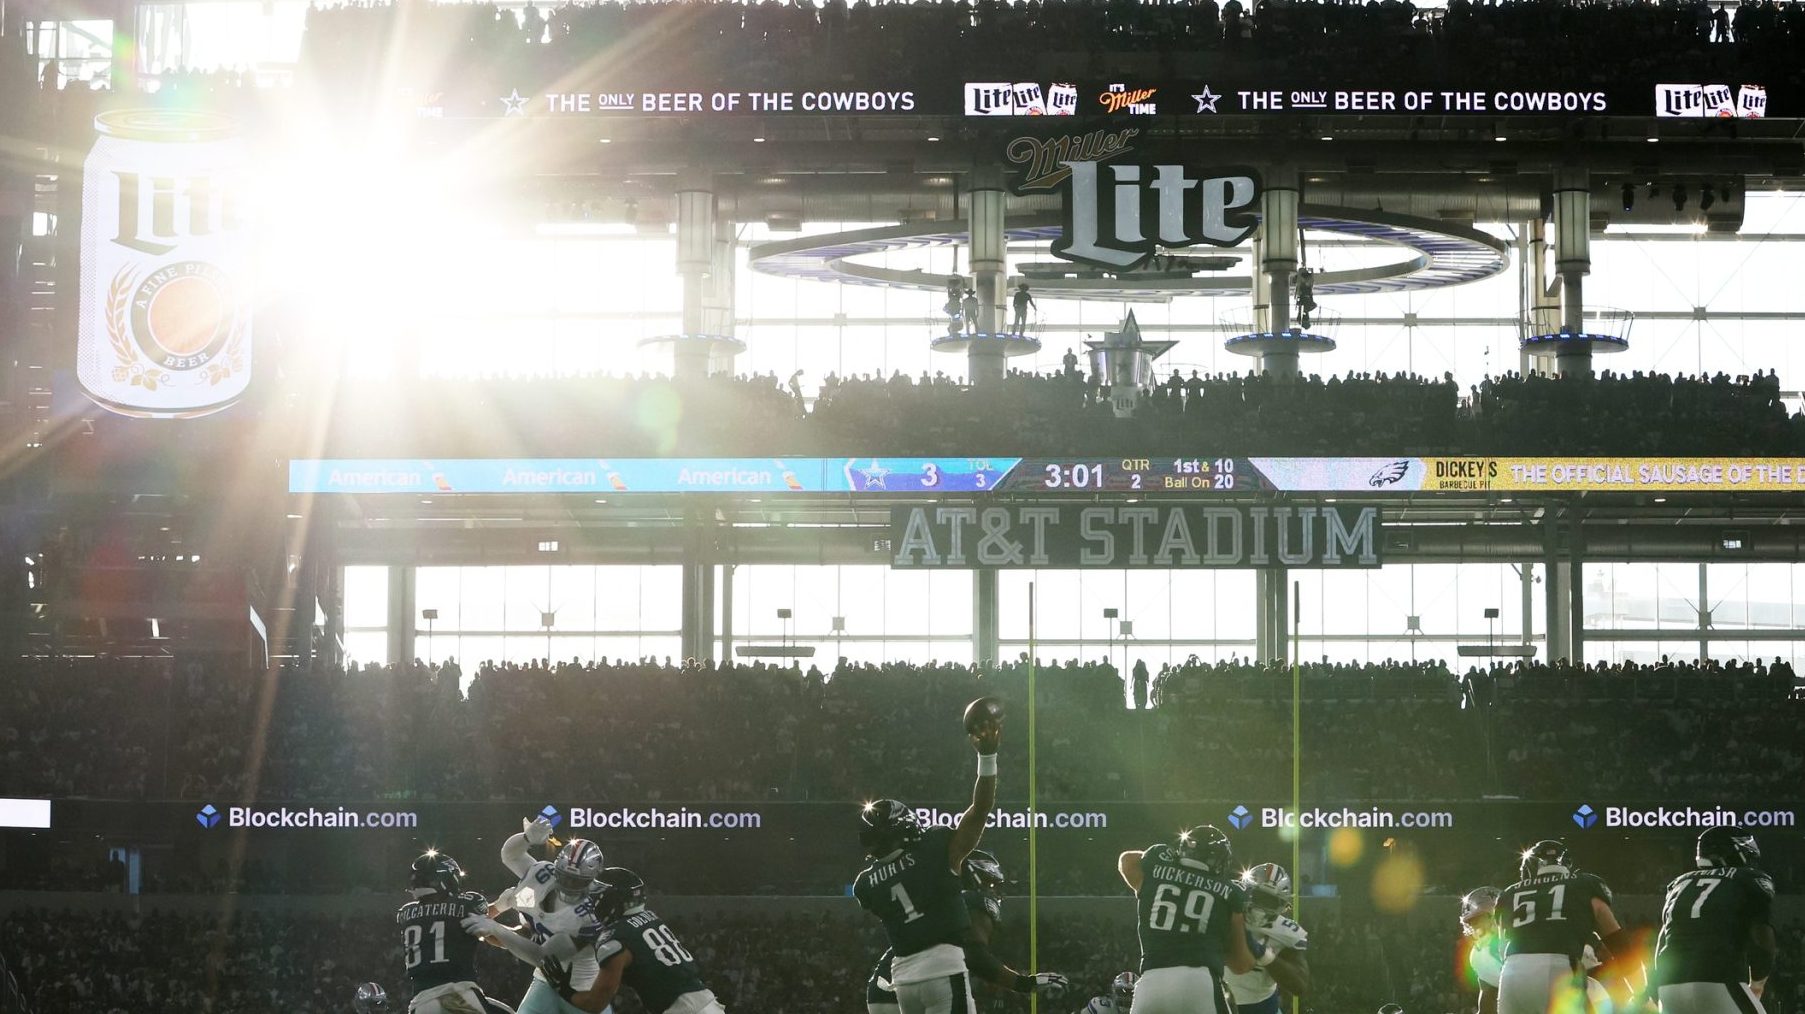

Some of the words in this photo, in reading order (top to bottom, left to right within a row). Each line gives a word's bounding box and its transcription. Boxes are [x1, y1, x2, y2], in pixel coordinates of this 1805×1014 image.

[546, 93, 590, 112] THE
[598, 93, 635, 105] ONLY
[642, 93, 703, 111] BEER
[711, 93, 741, 111] OF
[748, 93, 794, 111] THE
[801, 92, 915, 111] COWBOYS
[973, 87, 1011, 114] Lite
[1013, 85, 1040, 108] Lite
[1053, 92, 1077, 109] Lite
[1100, 89, 1156, 113] Miller
[1237, 92, 1283, 110] THE
[1290, 92, 1327, 104] ONLY
[1334, 92, 1396, 110] BEER
[1404, 92, 1434, 110] OF
[1440, 92, 1486, 111] THE
[1494, 92, 1607, 111] COWBOYS
[1665, 89, 1701, 116] Lite
[1703, 88, 1730, 110] Lite
[1742, 94, 1766, 111] Lite
[1128, 103, 1157, 115] TIME
[1006, 128, 1139, 190] Miller
[1058, 161, 1255, 267] Lite
[135, 298, 147, 309] A
[143, 265, 178, 297] FINE
[163, 352, 210, 368] BEER
[920, 463, 939, 487] 3
[968, 459, 993, 471] TOL
[1122, 459, 1150, 472] QTR
[1174, 460, 1200, 473] 1st
[1215, 460, 1234, 473] 10
[1510, 464, 1547, 484] THE
[1551, 464, 1635, 484] OFFICIAL
[1638, 464, 1723, 484] SAUSAGE
[1728, 464, 1752, 484] OF
[1756, 465, 1792, 484] THE
[328, 468, 421, 487] American
[503, 468, 596, 486] American
[678, 467, 772, 486] American
[975, 474, 986, 488] 3
[1044, 464, 1103, 488] 3:01
[1131, 475, 1141, 489] 2
[1165, 476, 1188, 489] Ball
[1191, 476, 1210, 489] On
[1214, 475, 1234, 489] 20
[1439, 481, 1477, 489] BARBECUE
[894, 507, 1060, 566] AT&T
[1079, 507, 1377, 566] STADIUM
[228, 806, 417, 827] Blockchain.com
[569, 807, 761, 828] Blockchain.com
[915, 807, 1107, 828] Blocchain.com
[1606, 805, 1795, 827] Blockchain.com
[1152, 864, 1233, 900] DICKERSON
[890, 881, 925, 924] 1
[1149, 884, 1216, 934] 69
[1512, 884, 1569, 929] 51
[404, 920, 450, 970] 81
[642, 924, 694, 967] 88
